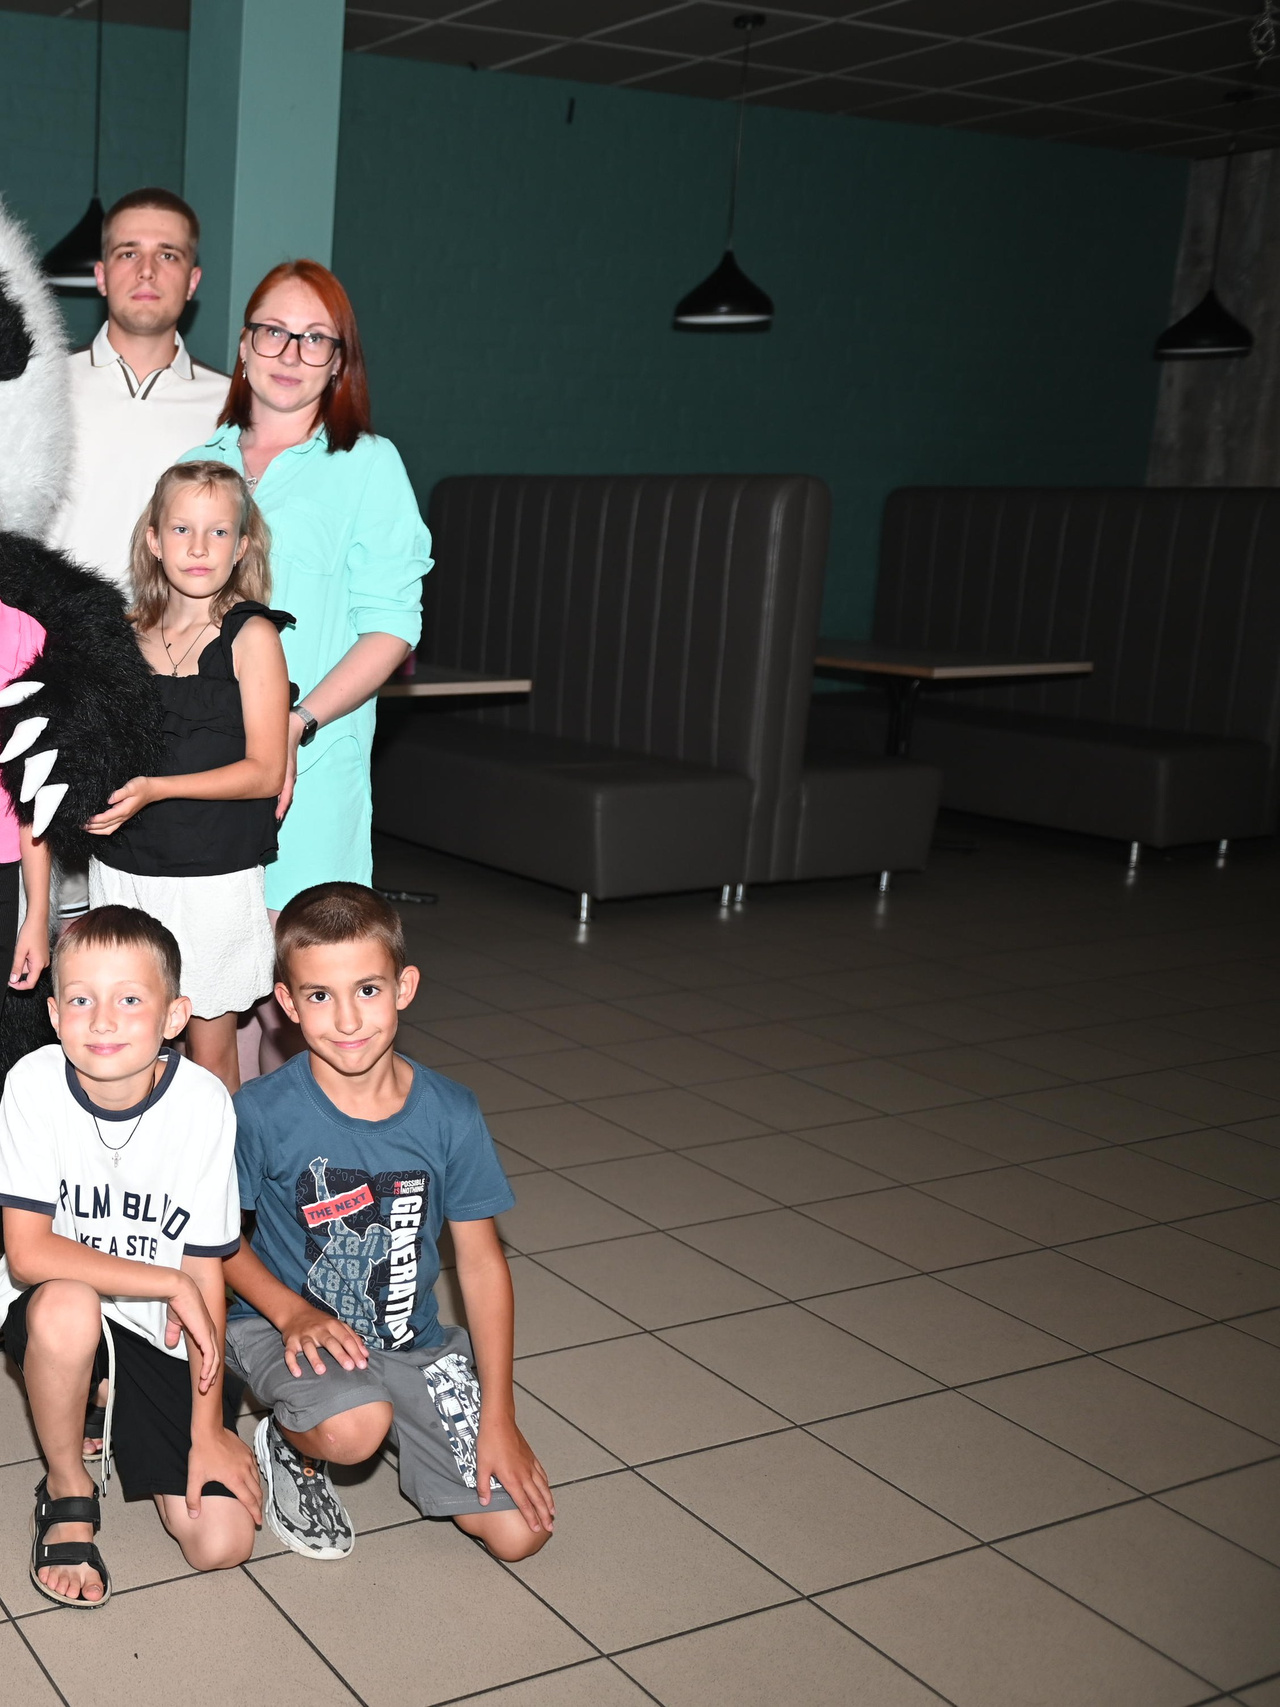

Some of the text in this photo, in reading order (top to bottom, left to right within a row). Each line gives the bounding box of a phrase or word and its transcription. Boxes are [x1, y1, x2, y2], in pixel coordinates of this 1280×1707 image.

[59, 1179, 111, 1219] PLM
[308, 1192, 366, 1220] THE NEXT
[109, 1236, 118, 1257] A
